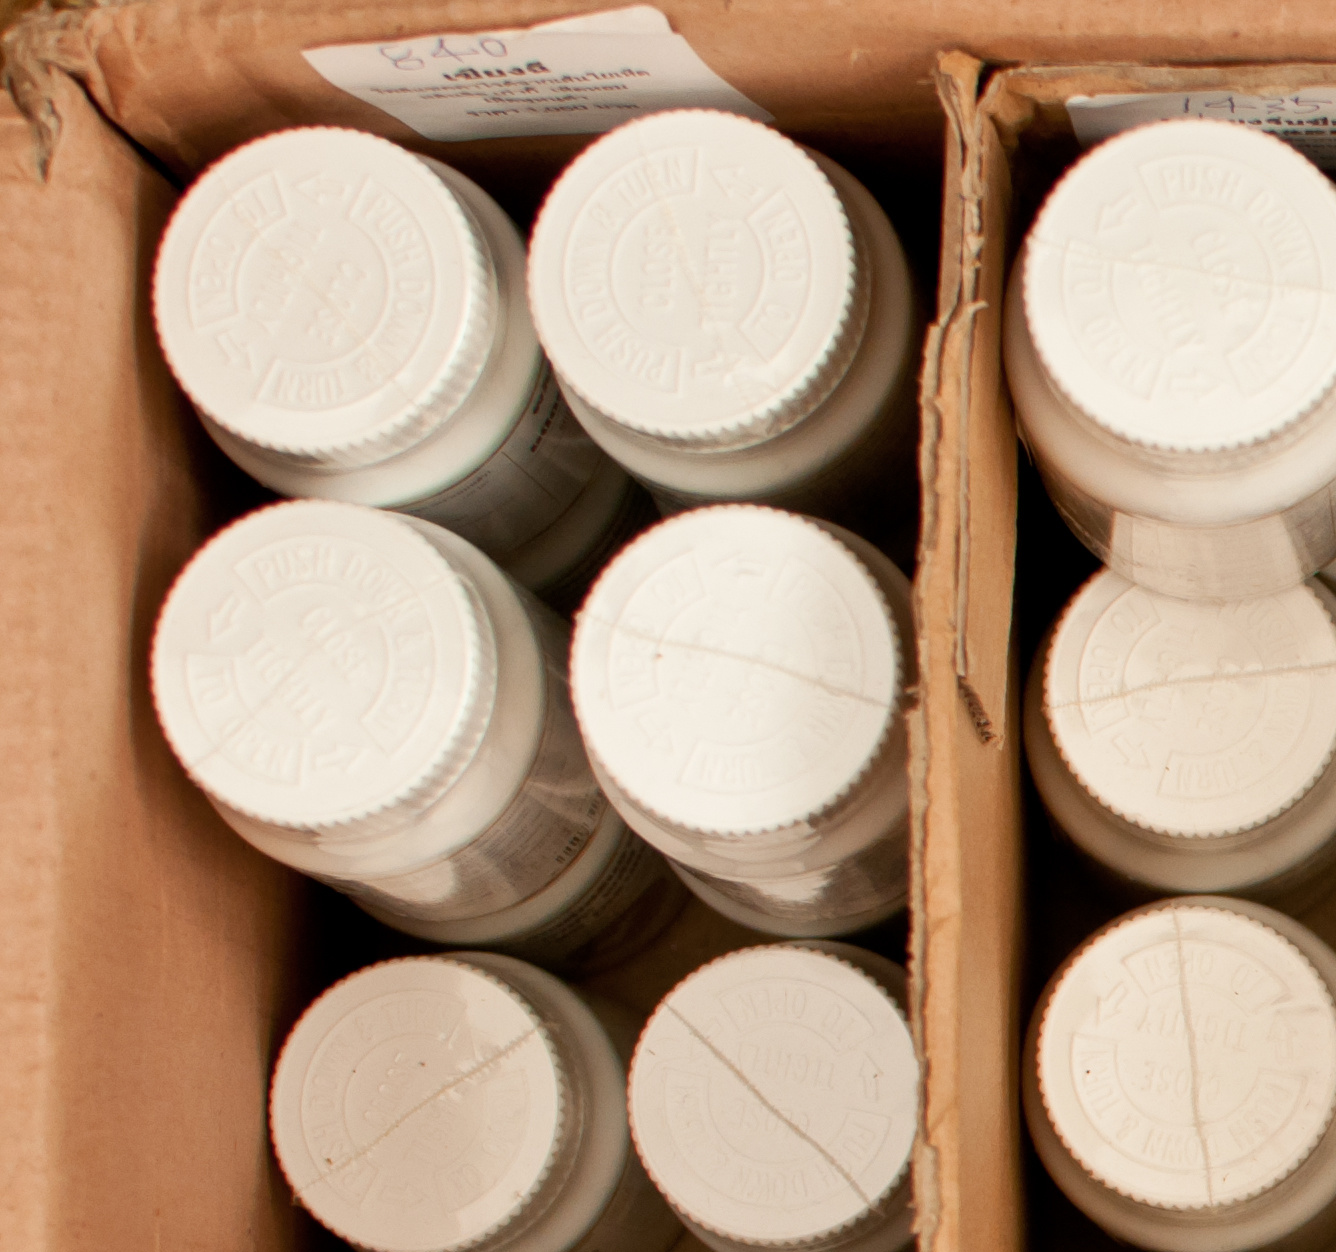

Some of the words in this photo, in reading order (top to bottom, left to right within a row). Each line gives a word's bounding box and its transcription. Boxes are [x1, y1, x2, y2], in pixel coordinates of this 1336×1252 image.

[230, 181, 276, 230] TO
[605, 150, 684, 206] TURN
[198, 227, 242, 313] OPEN
[363, 190, 422, 269] PUSH
[637, 220, 679, 311] CLOSE
[695, 213, 738, 332] TIGHTLY
[755, 207, 803, 292] OPEN
[247, 217, 326, 336] TIGHTLY
[302, 257, 371, 352] CLOSE
[571, 229, 612, 321] DOWN
[374, 280, 425, 368] DOWN
[593, 319, 666, 388] PUSH
[750, 304, 794, 353] TO
[271, 371, 354, 411] TURN
[249, 546, 333, 586] PUSH
[339, 553, 420, 626] DOWN
[239, 626, 340, 731] TIGHTLY
[295, 601, 378, 688] CLOSE
[192, 666, 233, 707] TO
[215, 710, 295, 775] OPEN
